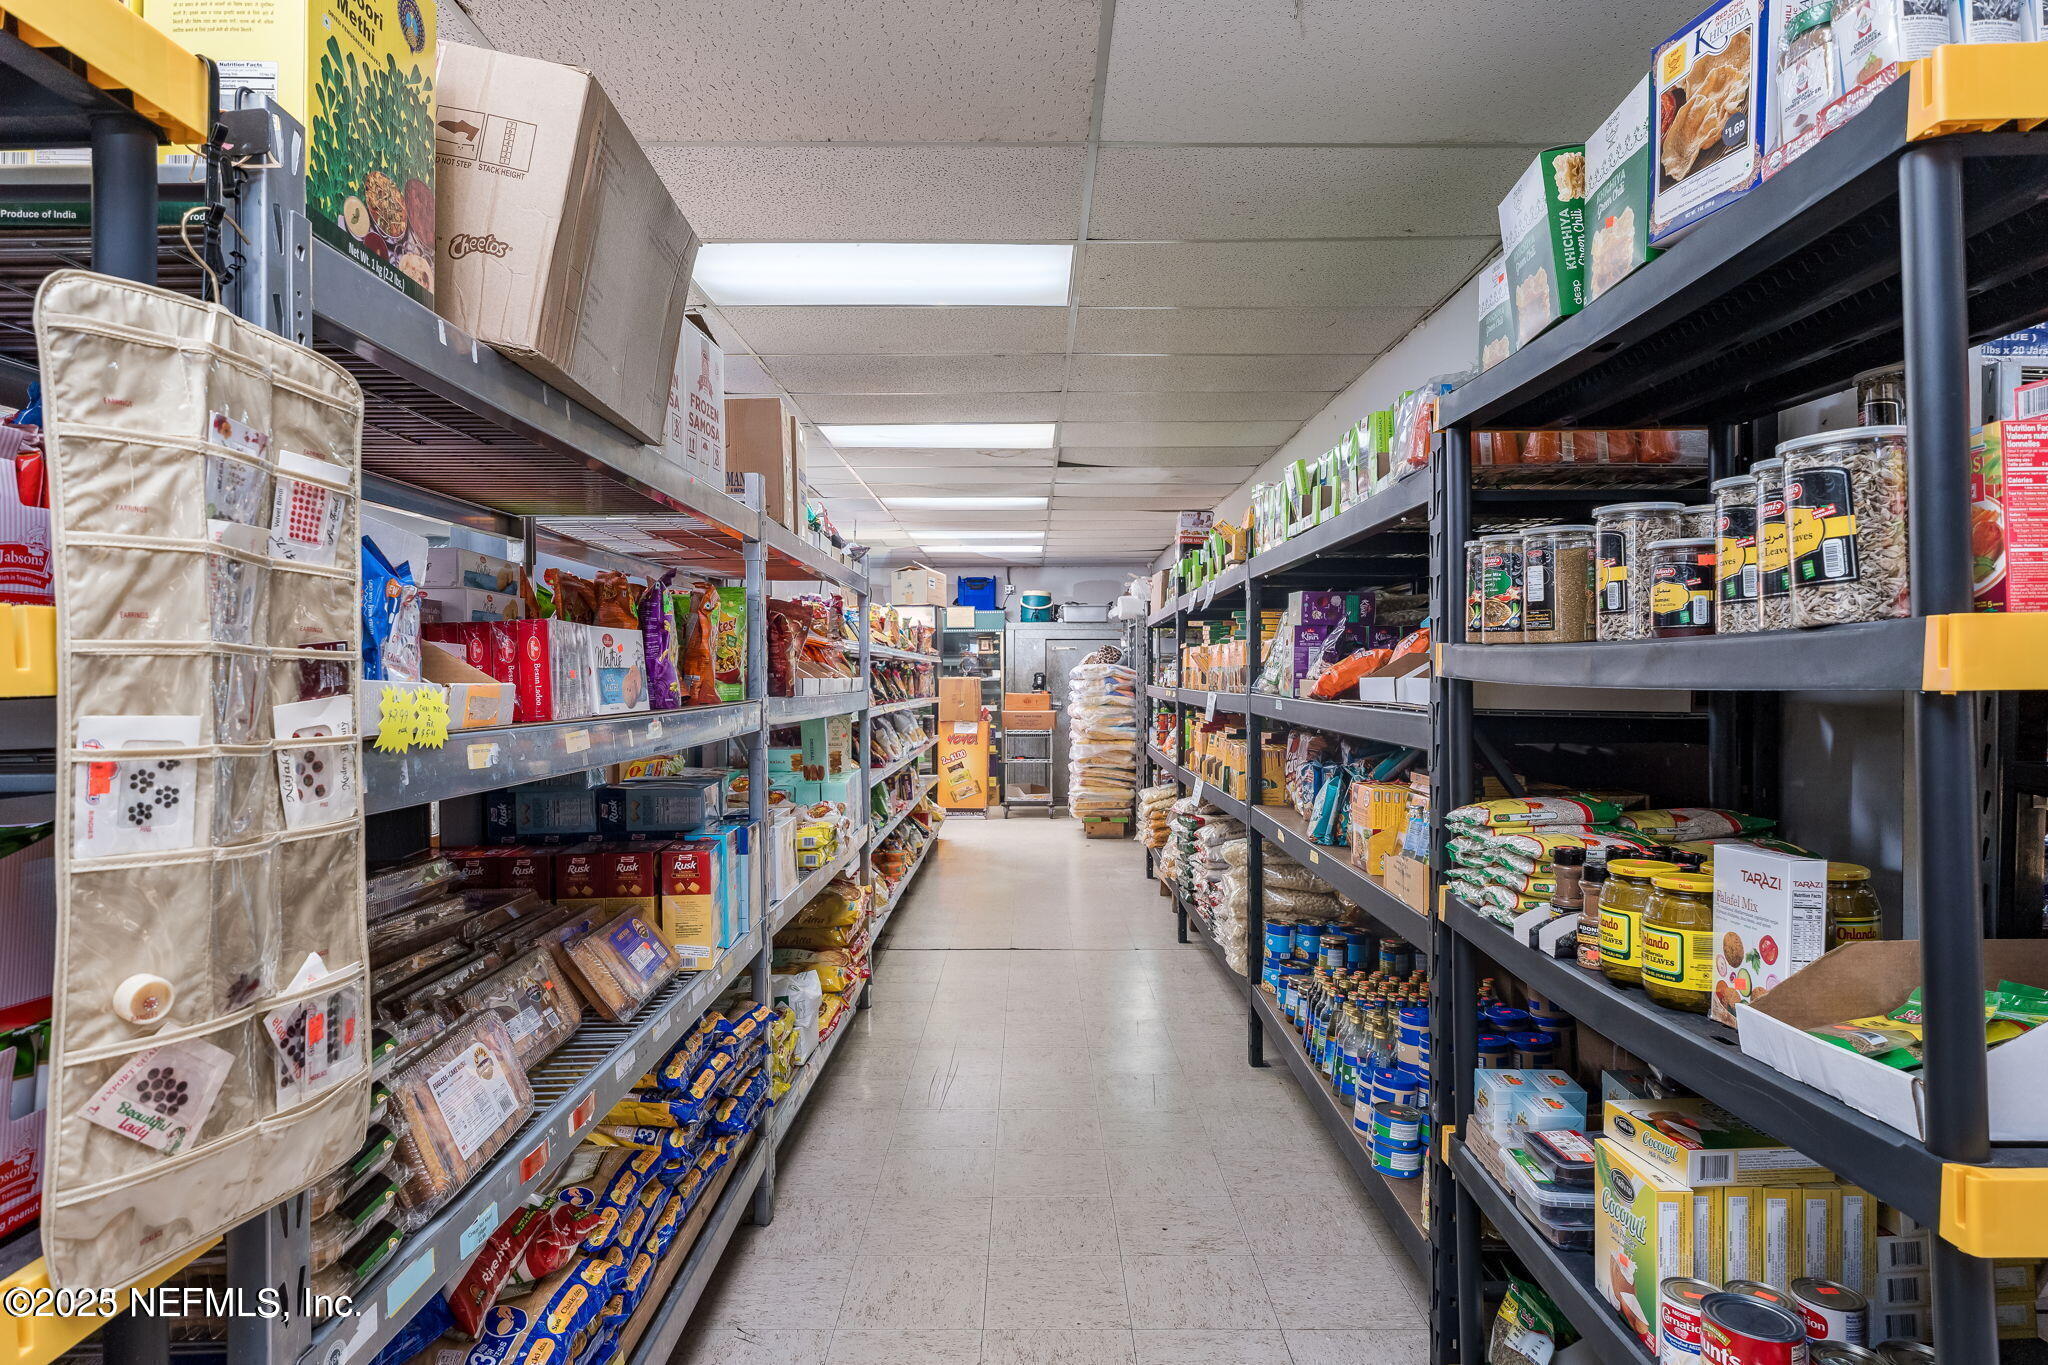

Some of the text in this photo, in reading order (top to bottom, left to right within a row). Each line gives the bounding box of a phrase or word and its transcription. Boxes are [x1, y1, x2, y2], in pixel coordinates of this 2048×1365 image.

[337, 0, 375, 46] Methi
[1724, 119, 1746, 138] $1.69
[442, 157, 472, 169] NOT STEP
[478, 163, 525, 181] STACK HEIGHT
[0, 209, 77, 219] Produce of India
[449, 233, 509, 260] Cheetos
[1558, 208, 1577, 270] KHICHIYA
[348, 242, 360, 260] Net
[360, 249, 371, 267] Wt.
[1573, 279, 1582, 305] deep
[2012, 346, 2024, 355] 20
[690, 393, 719, 424] FROZEN
[688, 412, 720, 441] SAMOSA
[2006, 424, 2035, 432] Nutrition
[274, 506, 282, 527] Velvet
[0, 549, 44, 566] Jabsons
[462, 866, 484, 877] Rusk
[512, 865, 535, 876] Rusk
[567, 863, 591, 874] Rusk
[616, 862, 639, 873] Rusk
[674, 860, 697, 871] Rusk
[1741, 869, 1782, 891] TARAZI
[1793, 880, 1824, 889] TARAZI
[1716, 889, 1758, 913] Falafel Mix
[1600, 914, 1618, 930] lando
[1603, 936, 1623, 946] LEAVES
[1837, 926, 1877, 940] Orlando
[1649, 956, 1675, 966] LEAVES
[117, 1101, 173, 1132] Beautiful
[118, 1117, 150, 1141] Lady
[1641, 1131, 1678, 1163] Coconut
[8, 1202, 39, 1226] Peanut
[1601, 1186, 1646, 1245] Coconut
[1662, 1306, 1701, 1335] Carnatio
[1701, 1337, 1741, 1365] unt's
